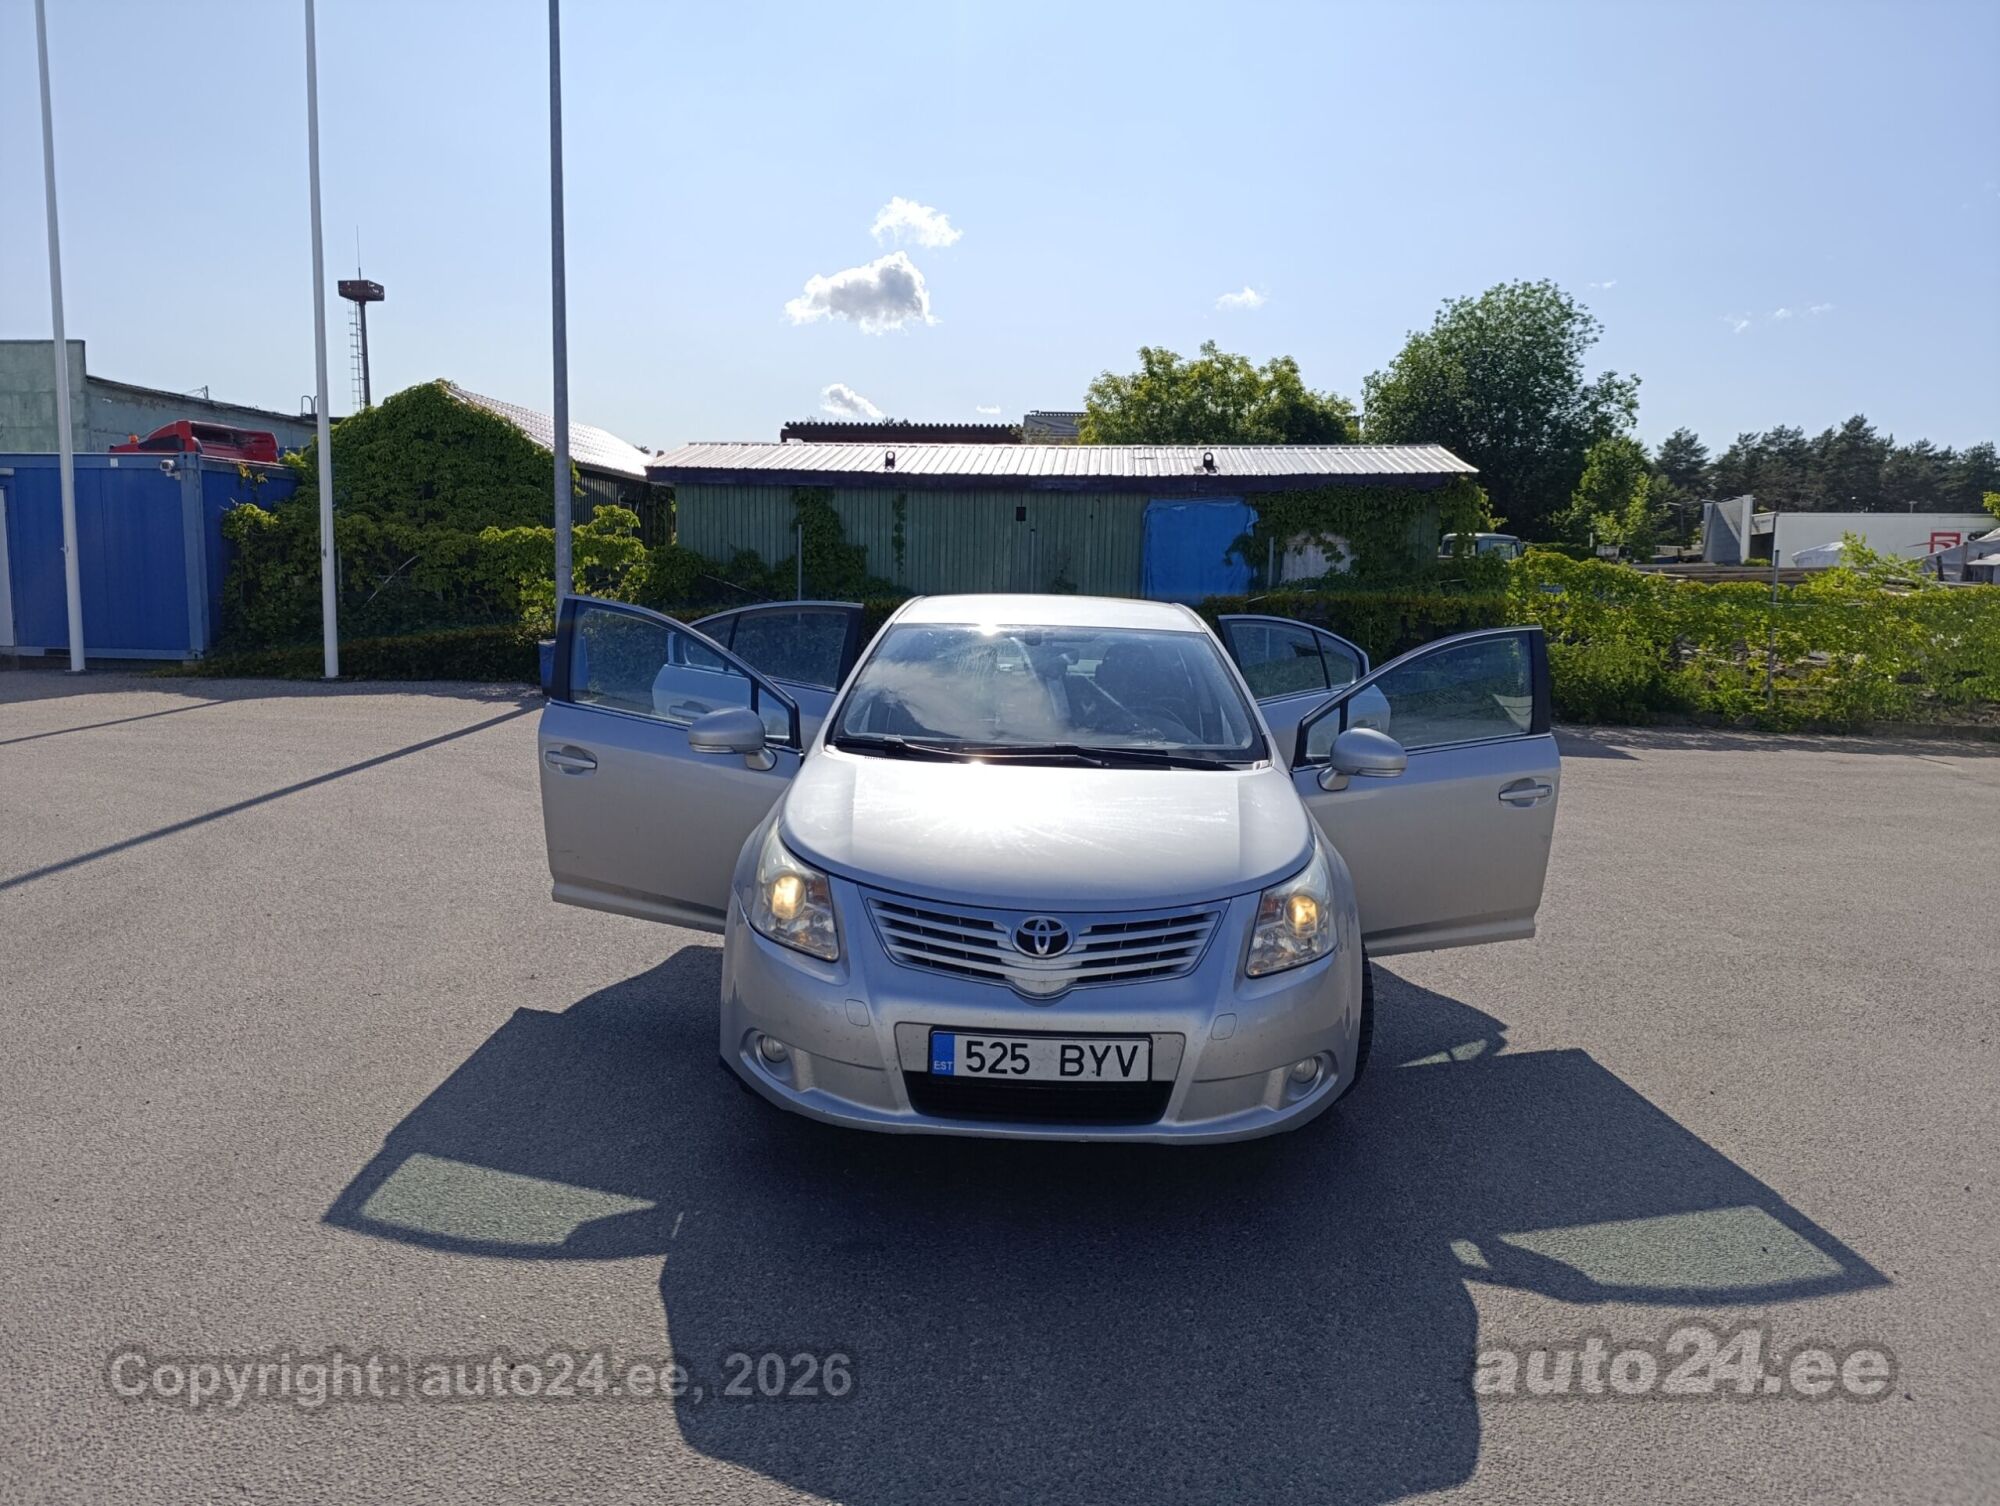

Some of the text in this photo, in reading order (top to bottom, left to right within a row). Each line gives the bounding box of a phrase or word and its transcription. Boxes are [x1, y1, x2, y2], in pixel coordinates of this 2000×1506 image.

[933, 1060, 953, 1071] EST
[965, 1040, 1139, 1077] 525 BYV
